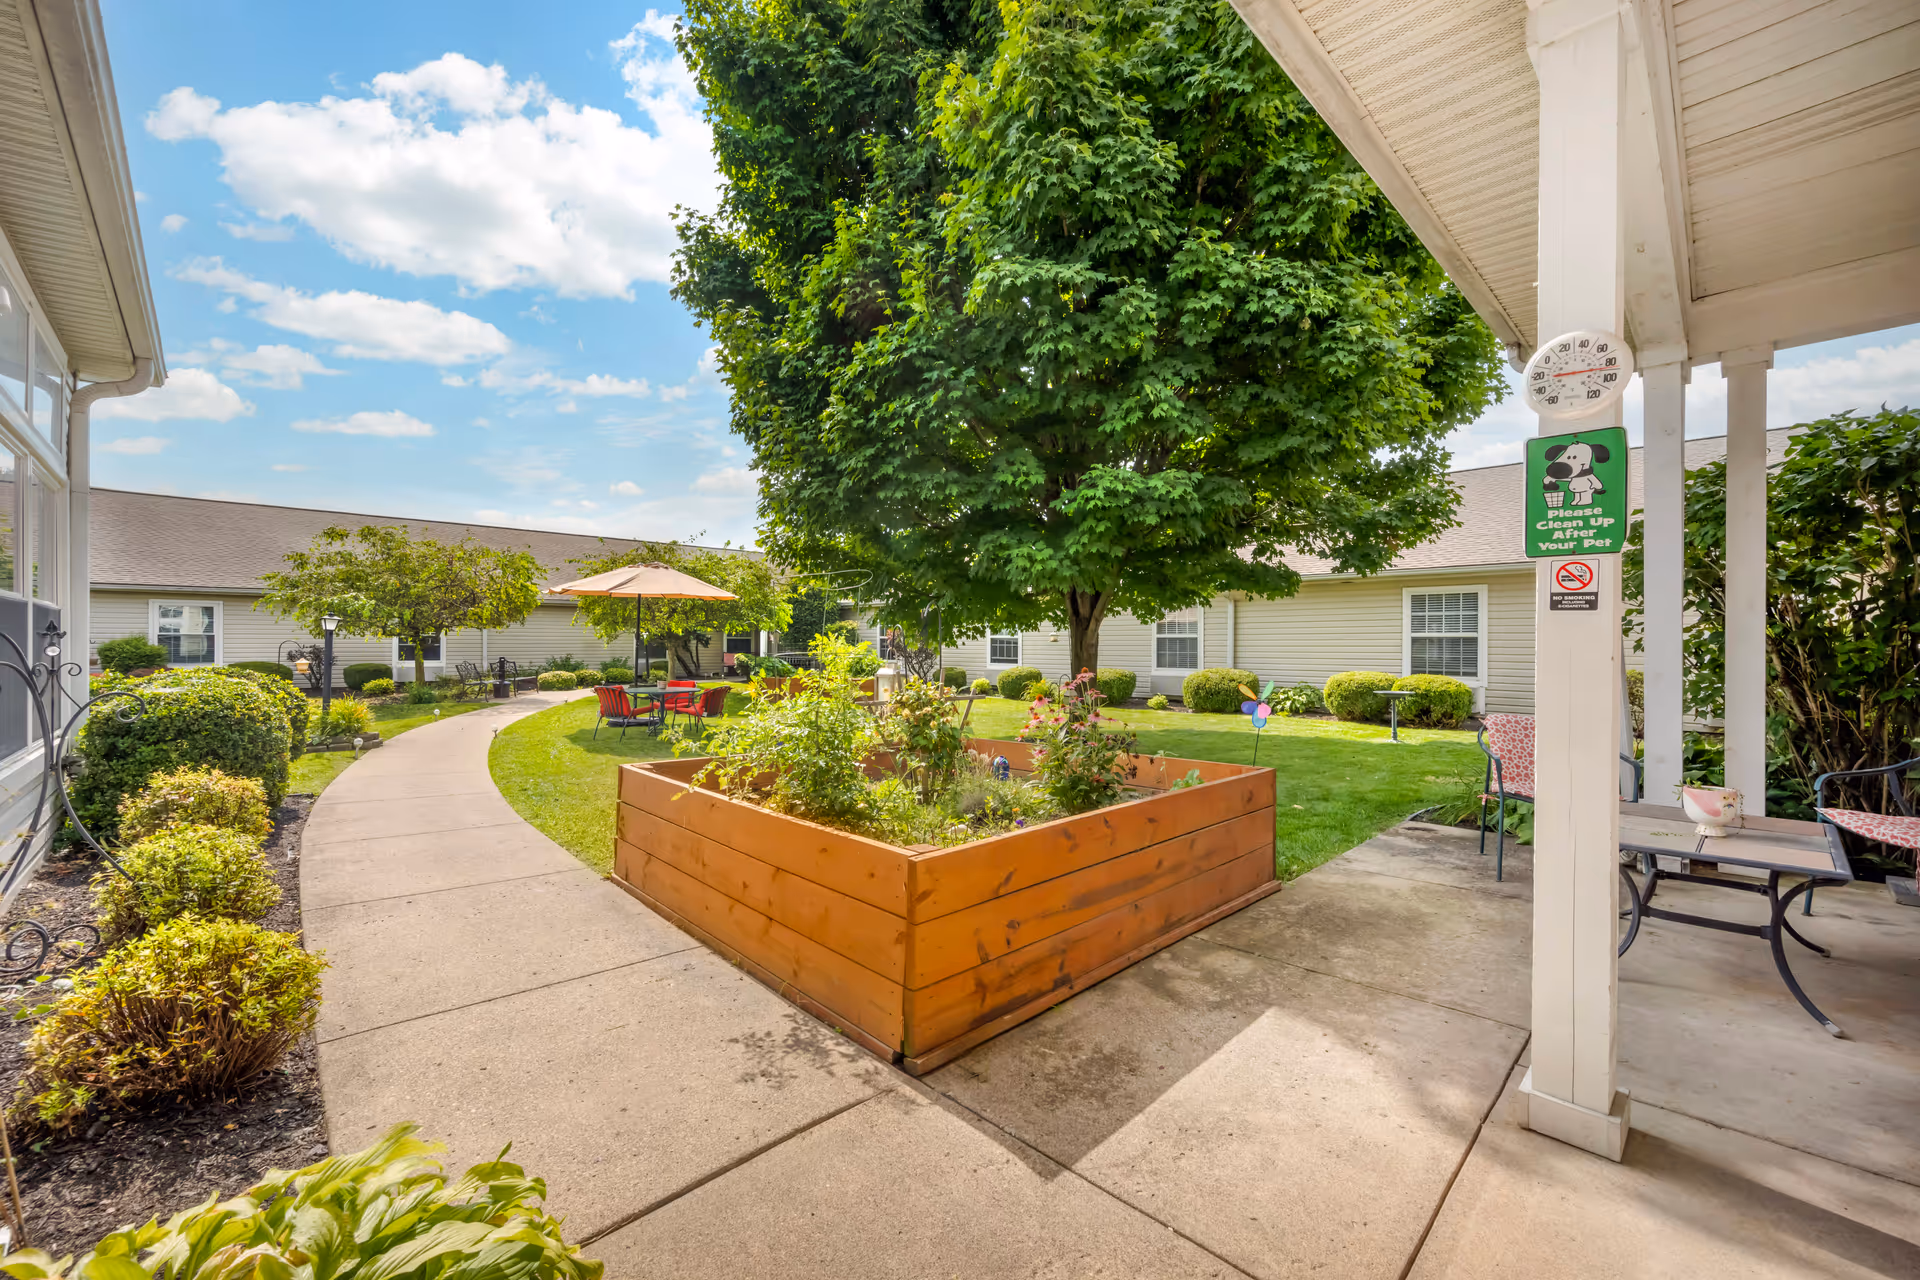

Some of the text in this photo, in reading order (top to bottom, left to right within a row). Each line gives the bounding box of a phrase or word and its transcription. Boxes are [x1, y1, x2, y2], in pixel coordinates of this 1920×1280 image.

[1559, 343, 1571, 352] 20
[1578, 339, 1589, 348] 40
[1597, 343, 1608, 353] 60
[1544, 356, 1551, 364] 0
[1605, 357, 1617, 366] 80
[1531, 371, 1545, 380] -20
[1603, 373, 1617, 383] 100
[1533, 386, 1546, 395] -40
[1587, 389, 1601, 399] 120
[1545, 396, 1559, 405] -60
[1547, 507, 1603, 519] Please
[1536, 519, 1584, 530] Clean
[1552, 528, 1597, 540] After
[1538, 538, 1613, 551] Your Pet
